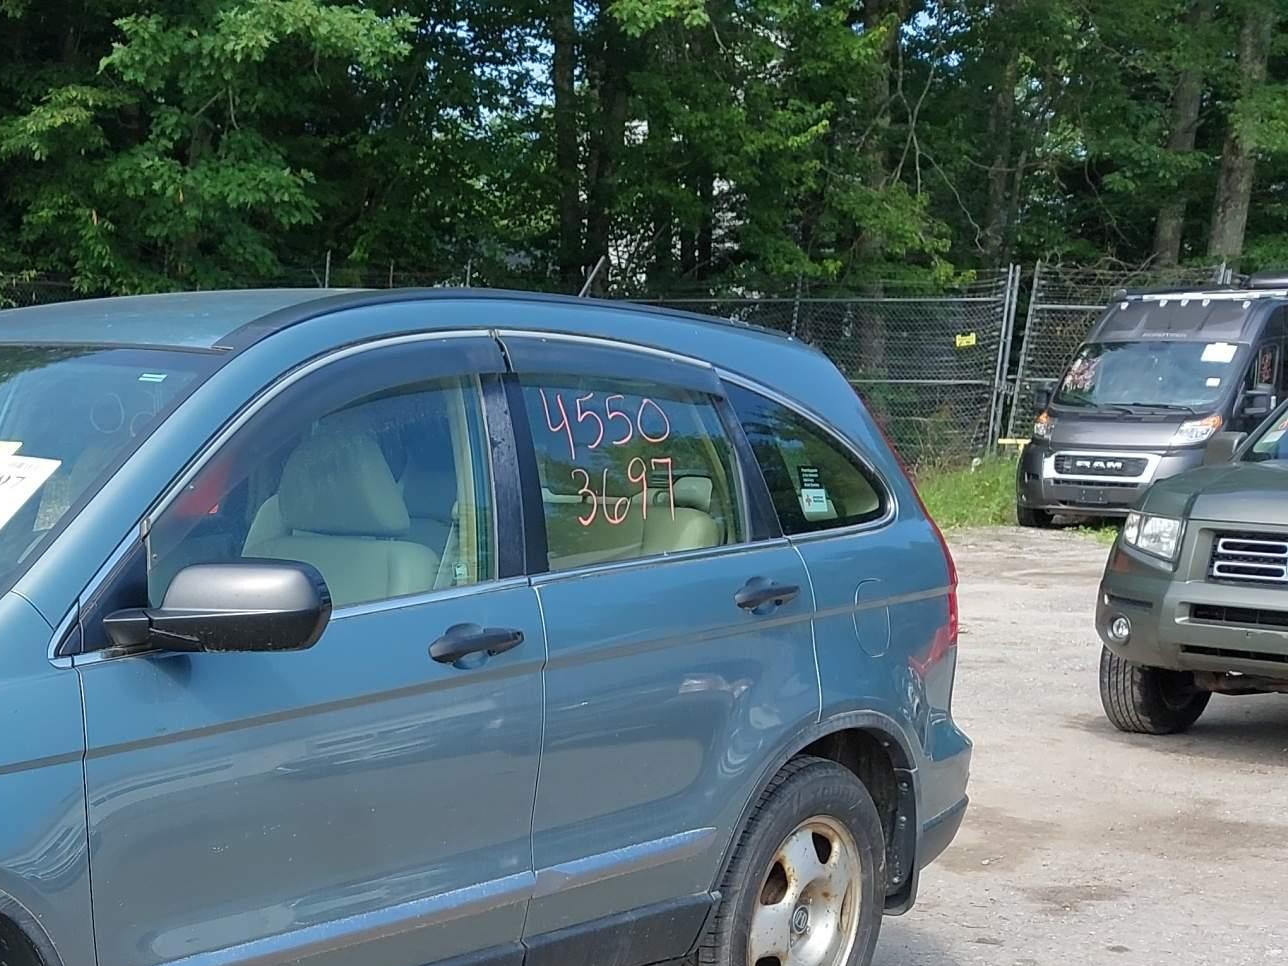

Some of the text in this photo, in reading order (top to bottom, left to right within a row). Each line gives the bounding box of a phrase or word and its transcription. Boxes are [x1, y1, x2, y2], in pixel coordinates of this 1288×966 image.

[540, 388, 671, 460] 4550
[571, 457, 676, 526] 3697
[1076, 460, 1123, 471] RAM
